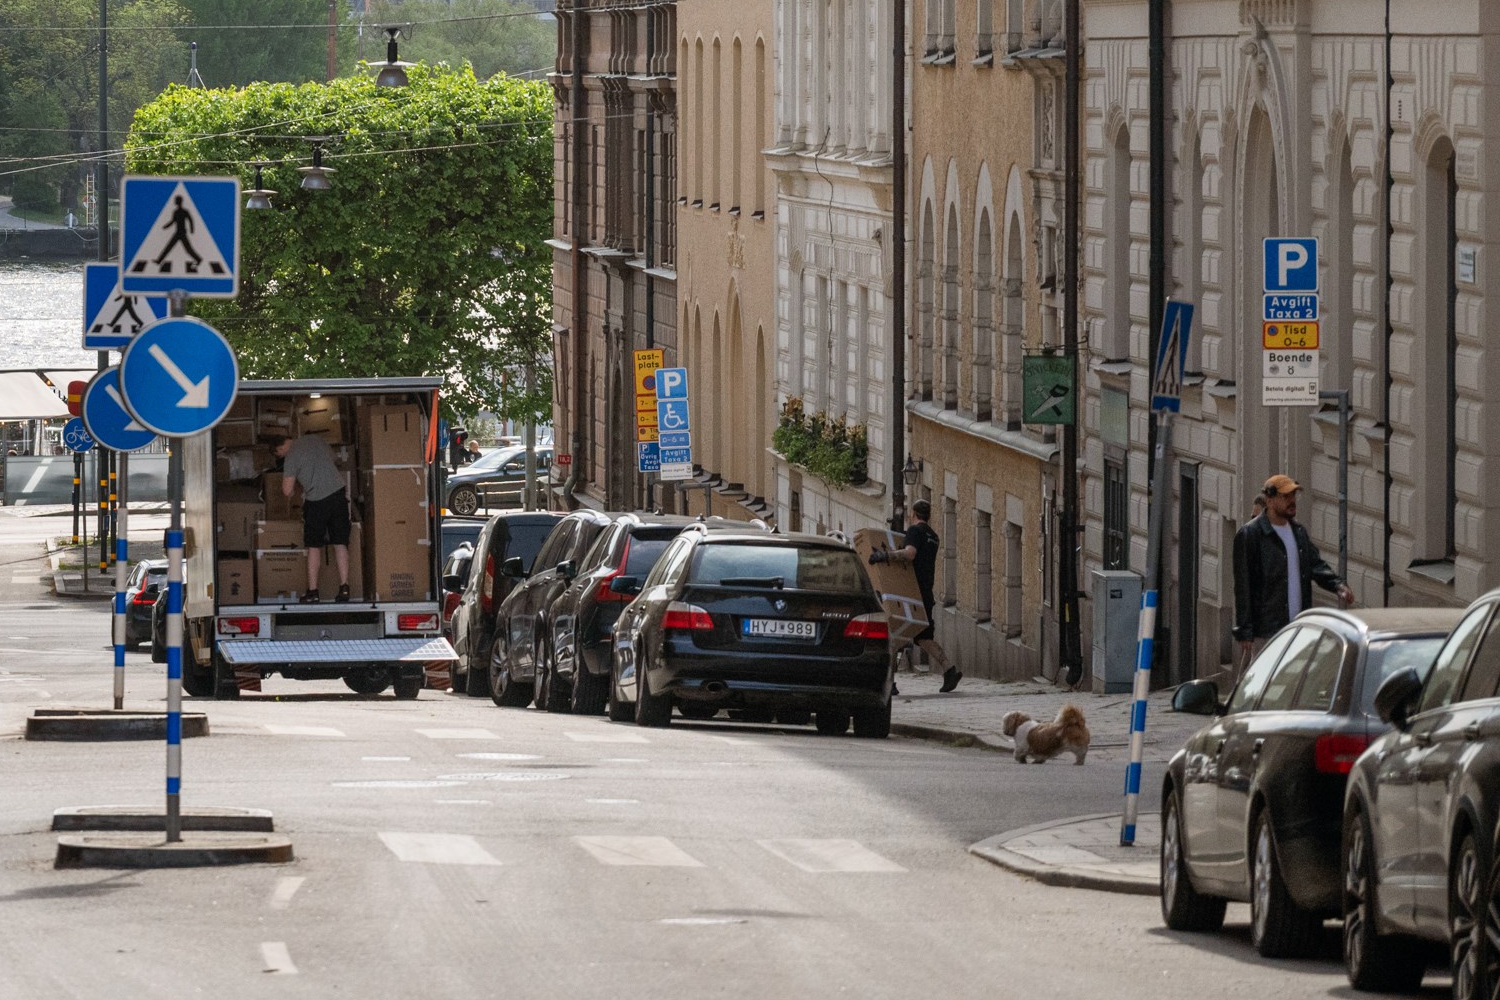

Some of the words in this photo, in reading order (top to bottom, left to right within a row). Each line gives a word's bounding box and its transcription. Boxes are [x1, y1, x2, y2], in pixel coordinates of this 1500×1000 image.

[1278, 243, 1309, 287] P
[1271, 296, 1311, 308] Avgift
[1269, 308, 1301, 318] Taxa
[1306, 308, 1313, 318] 2
[1283, 325, 1307, 334] Tisd
[1283, 338, 1306, 347] 0-6
[1269, 352, 1313, 362] Boende
[638, 361, 660, 370] plats
[663, 372, 682, 397] P
[751, 621, 778, 633] HYJ
[787, 622, 813, 635] 989
